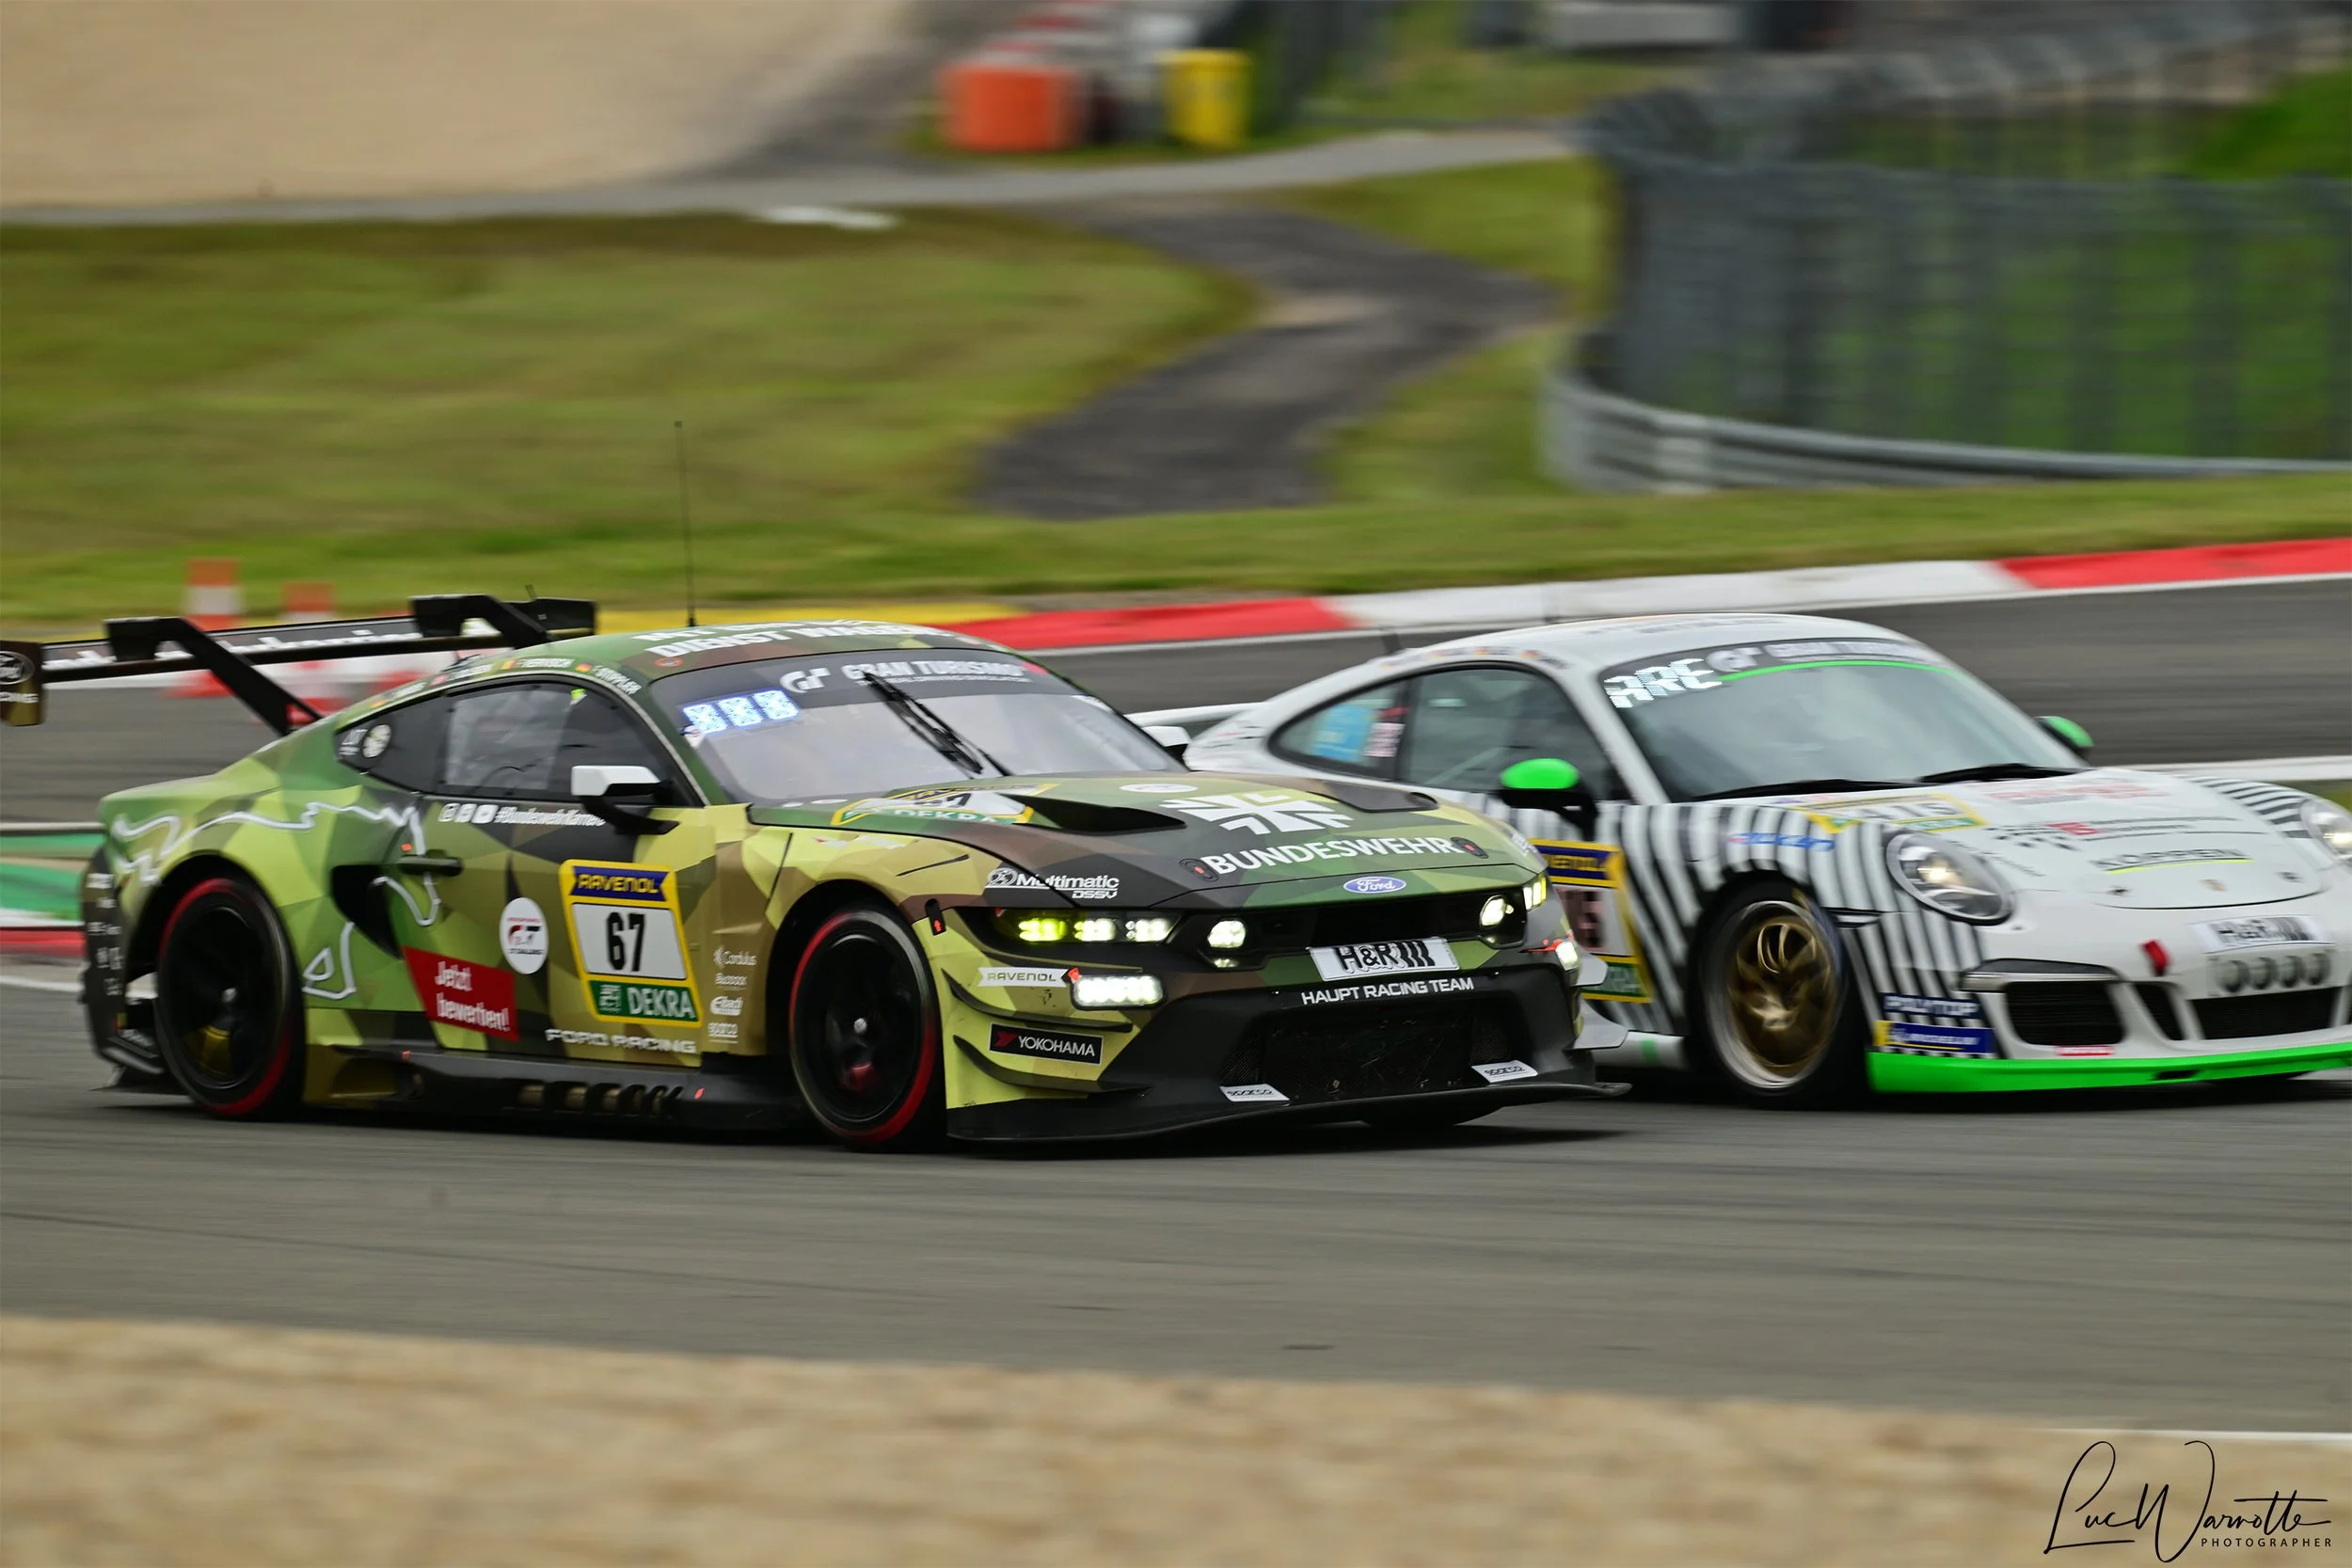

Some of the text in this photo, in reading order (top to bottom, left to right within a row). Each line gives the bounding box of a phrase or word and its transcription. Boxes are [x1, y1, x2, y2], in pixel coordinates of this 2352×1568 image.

[1200, 837, 1464, 874] BUNDESWEHR
[578, 874, 660, 894] RAVENOL
[1016, 873, 1120, 889] Multimatic
[1357, 879, 1396, 892] Ford
[1072, 890, 1118, 899] DSSV
[607, 912, 645, 972] 67
[1332, 943, 1399, 973] H&R
[987, 972, 1057, 982] RAVENOL
[1301, 977, 1474, 1006] HAUPT RACING TEAM
[627, 987, 696, 1019] DEKRA
[545, 1029, 697, 1053] FORD RACING
[1018, 1036, 1095, 1057] YOKOHAMA
